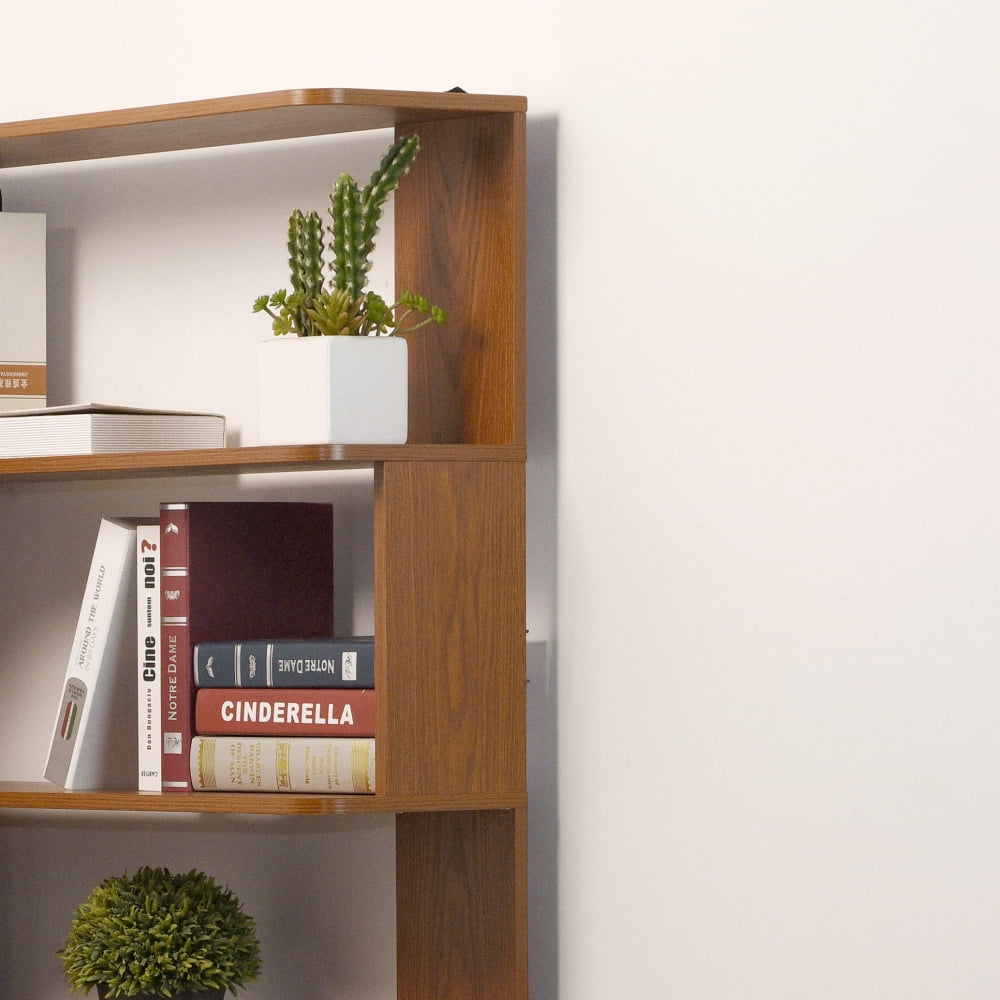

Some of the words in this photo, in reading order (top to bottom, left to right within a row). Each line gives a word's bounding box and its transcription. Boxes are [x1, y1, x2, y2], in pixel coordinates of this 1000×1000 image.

[78, 626, 92, 668] AROUND
[88, 604, 98, 624] THE
[93, 565, 106, 600] WORLD
[142, 636, 156, 682] Cine
[168, 635, 177, 673] DAME
[278, 659, 303, 674] DAME
[305, 659, 335, 674] NOTRE
[168, 676, 177, 721] NOTRE
[221, 701, 354, 725] CINDERELLA
